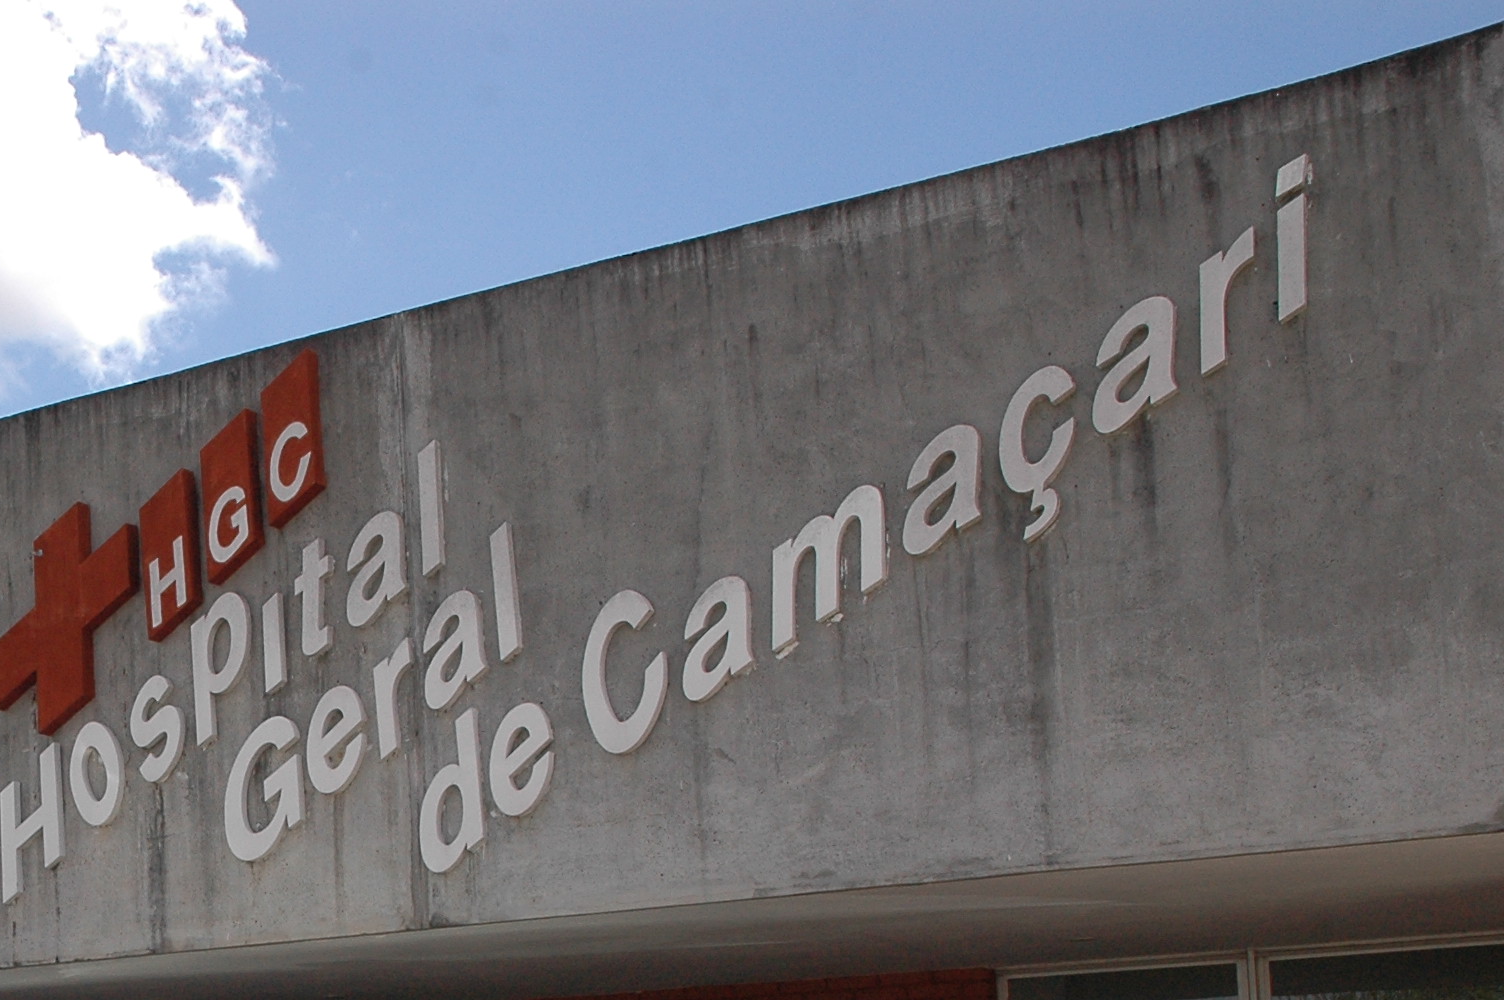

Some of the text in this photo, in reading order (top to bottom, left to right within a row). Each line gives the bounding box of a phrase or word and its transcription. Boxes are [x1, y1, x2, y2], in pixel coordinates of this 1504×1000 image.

[148, 420, 312, 629] HGC
[418, 153, 1313, 874] de Camaçari
[223, 520, 524, 862] Geral
